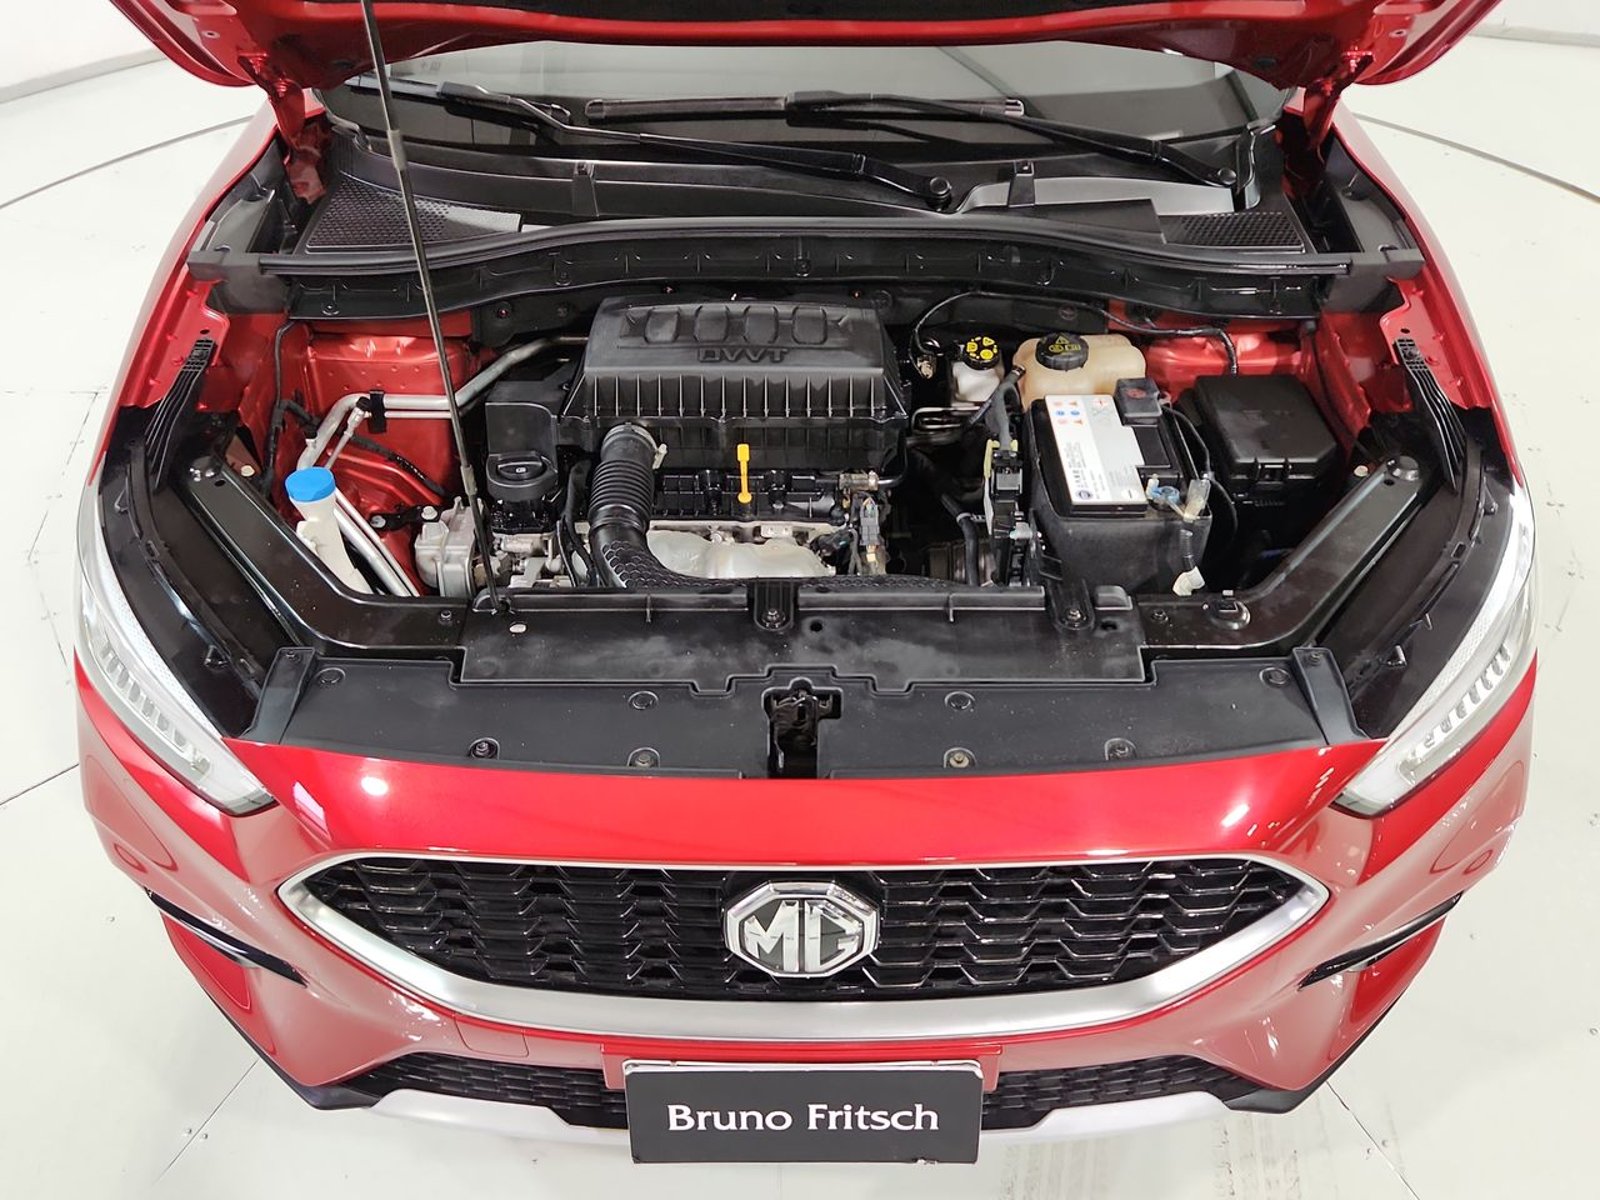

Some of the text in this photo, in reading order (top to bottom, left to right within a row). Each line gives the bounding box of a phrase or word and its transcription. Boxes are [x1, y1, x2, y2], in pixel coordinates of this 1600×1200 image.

[698, 347, 788, 363] DVVT
[744, 899, 862, 973] MG
[667, 1103, 939, 1131] Bruno Fritsch
